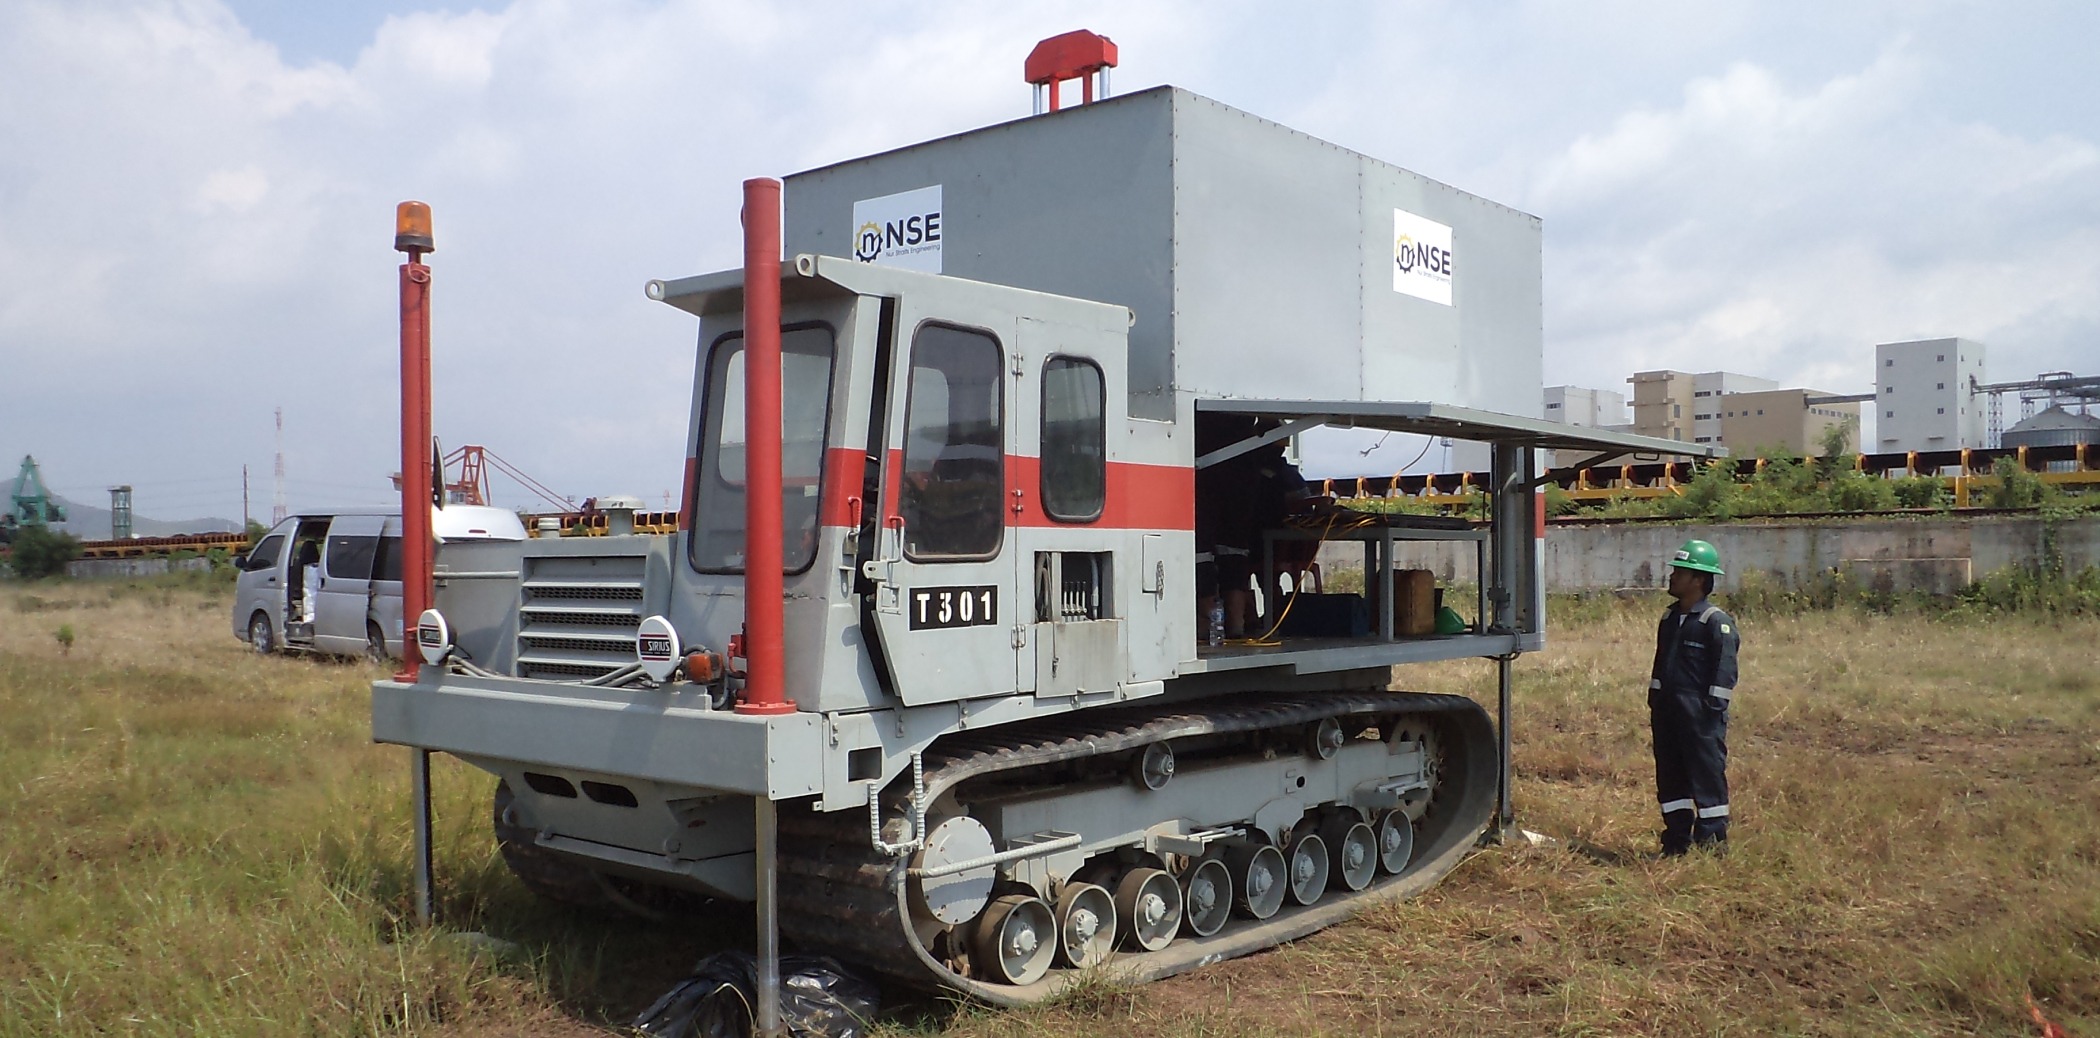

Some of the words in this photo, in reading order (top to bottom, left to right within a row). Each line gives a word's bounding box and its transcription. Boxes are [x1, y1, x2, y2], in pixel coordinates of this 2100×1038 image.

[886, 212, 940, 249] NSE
[1417, 241, 1450, 276] NSE
[647, 640, 670, 652] SIRIUS
